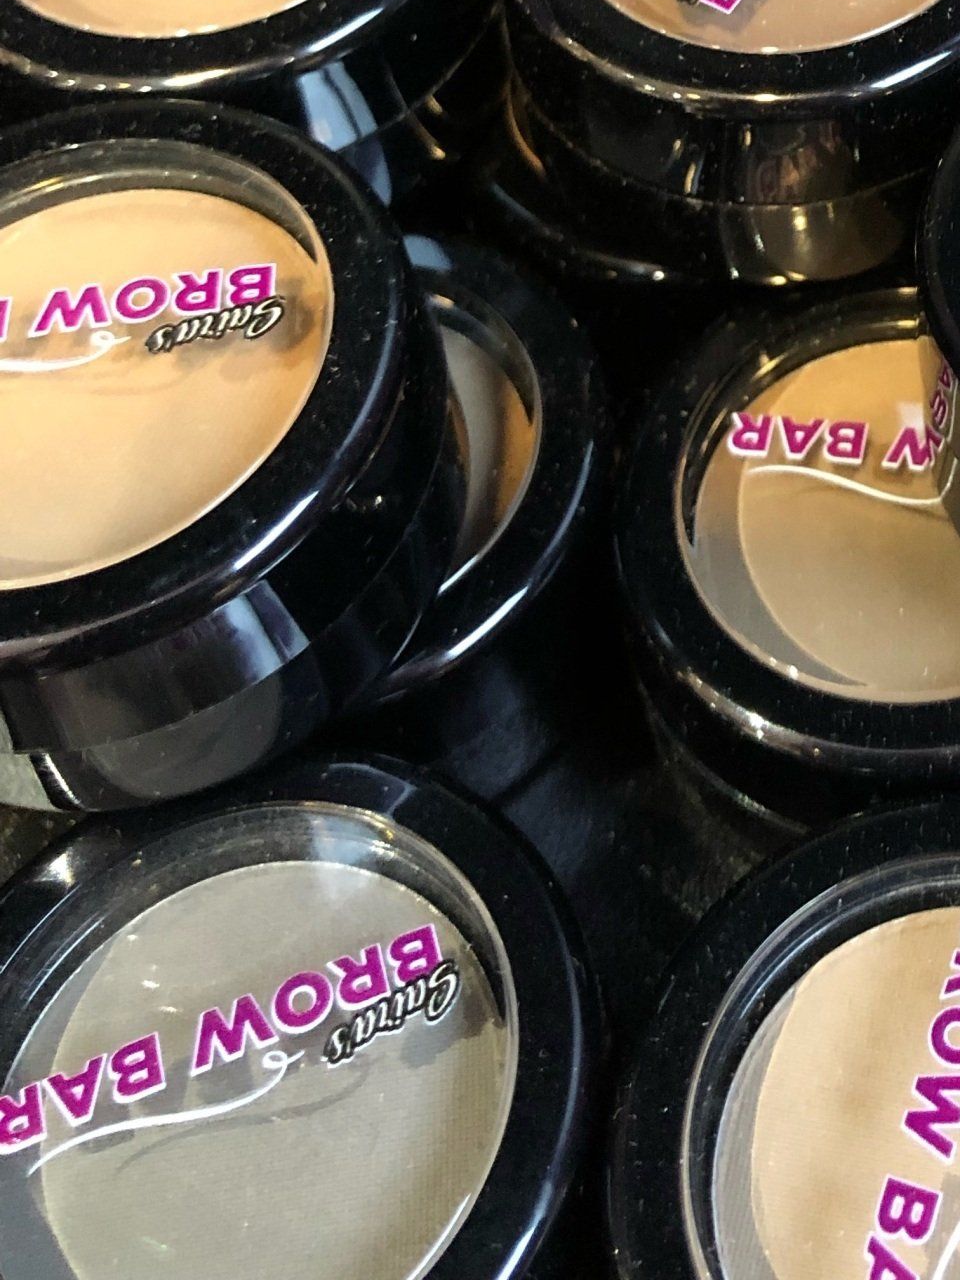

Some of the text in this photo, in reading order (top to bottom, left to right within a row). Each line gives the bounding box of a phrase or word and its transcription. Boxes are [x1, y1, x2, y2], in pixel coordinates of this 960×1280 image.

[27, 262, 277, 338] BROW
[144, 295, 287, 354] Saira's
[727, 412, 869, 465] BAR
[0, 923, 443, 1155] BROW BAR
[321, 958, 460, 1067] Saira's
